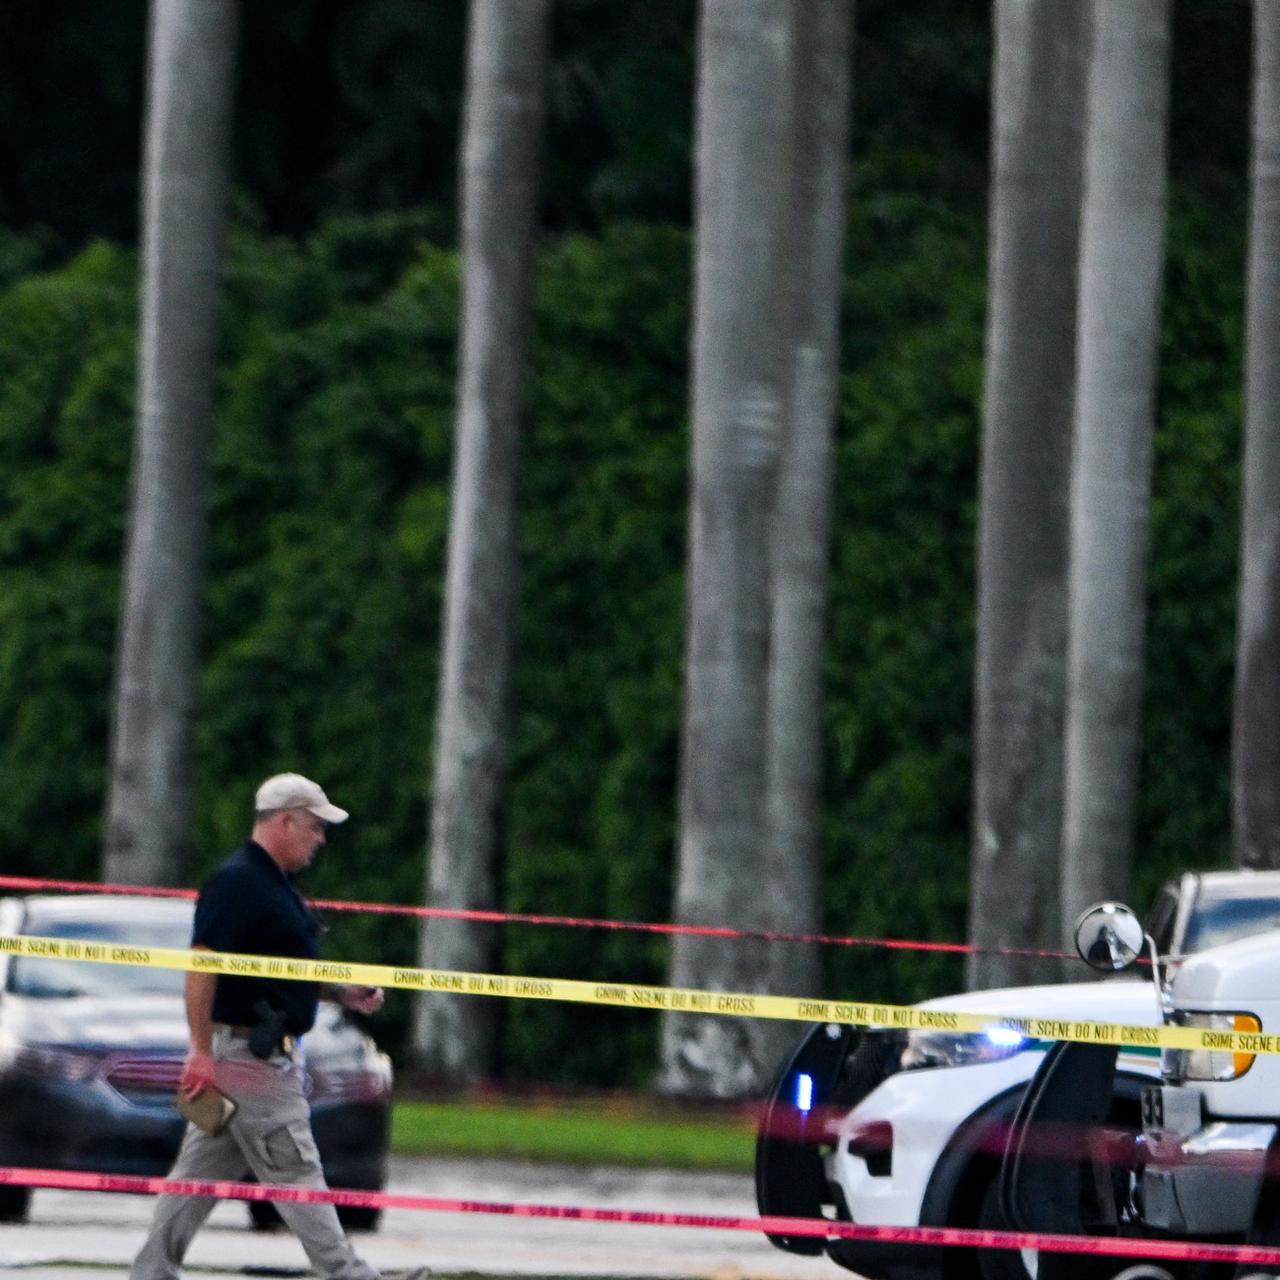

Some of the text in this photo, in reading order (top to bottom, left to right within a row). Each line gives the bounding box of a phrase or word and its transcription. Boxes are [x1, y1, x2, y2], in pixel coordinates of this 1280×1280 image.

[28, 939, 60, 955] SCENE
[66, 943, 80, 957] DO
[85, 945, 105, 959] NOT
[112, 947, 150, 963] CROSS
[192, 954, 352, 981] CRIME SCENE DO NOT CROSS
[394, 970, 553, 997] CRIME SCENE DO NOT CROSS
[595, 986, 755, 1012] CRIME SCENE DO NOT CROSS
[798, 1001, 957, 1029] CRIME SCENE DO NOT CROSS
[1037, 1020, 1071, 1037] SCENE
[1075, 1023, 1089, 1039] DO
[1094, 1024, 1116, 1041] NOT
[1121, 1026, 1158, 1044] CROSS
[1202, 1032, 1233, 1048] CRIME
[1238, 1034, 1271, 1051] SCENE
